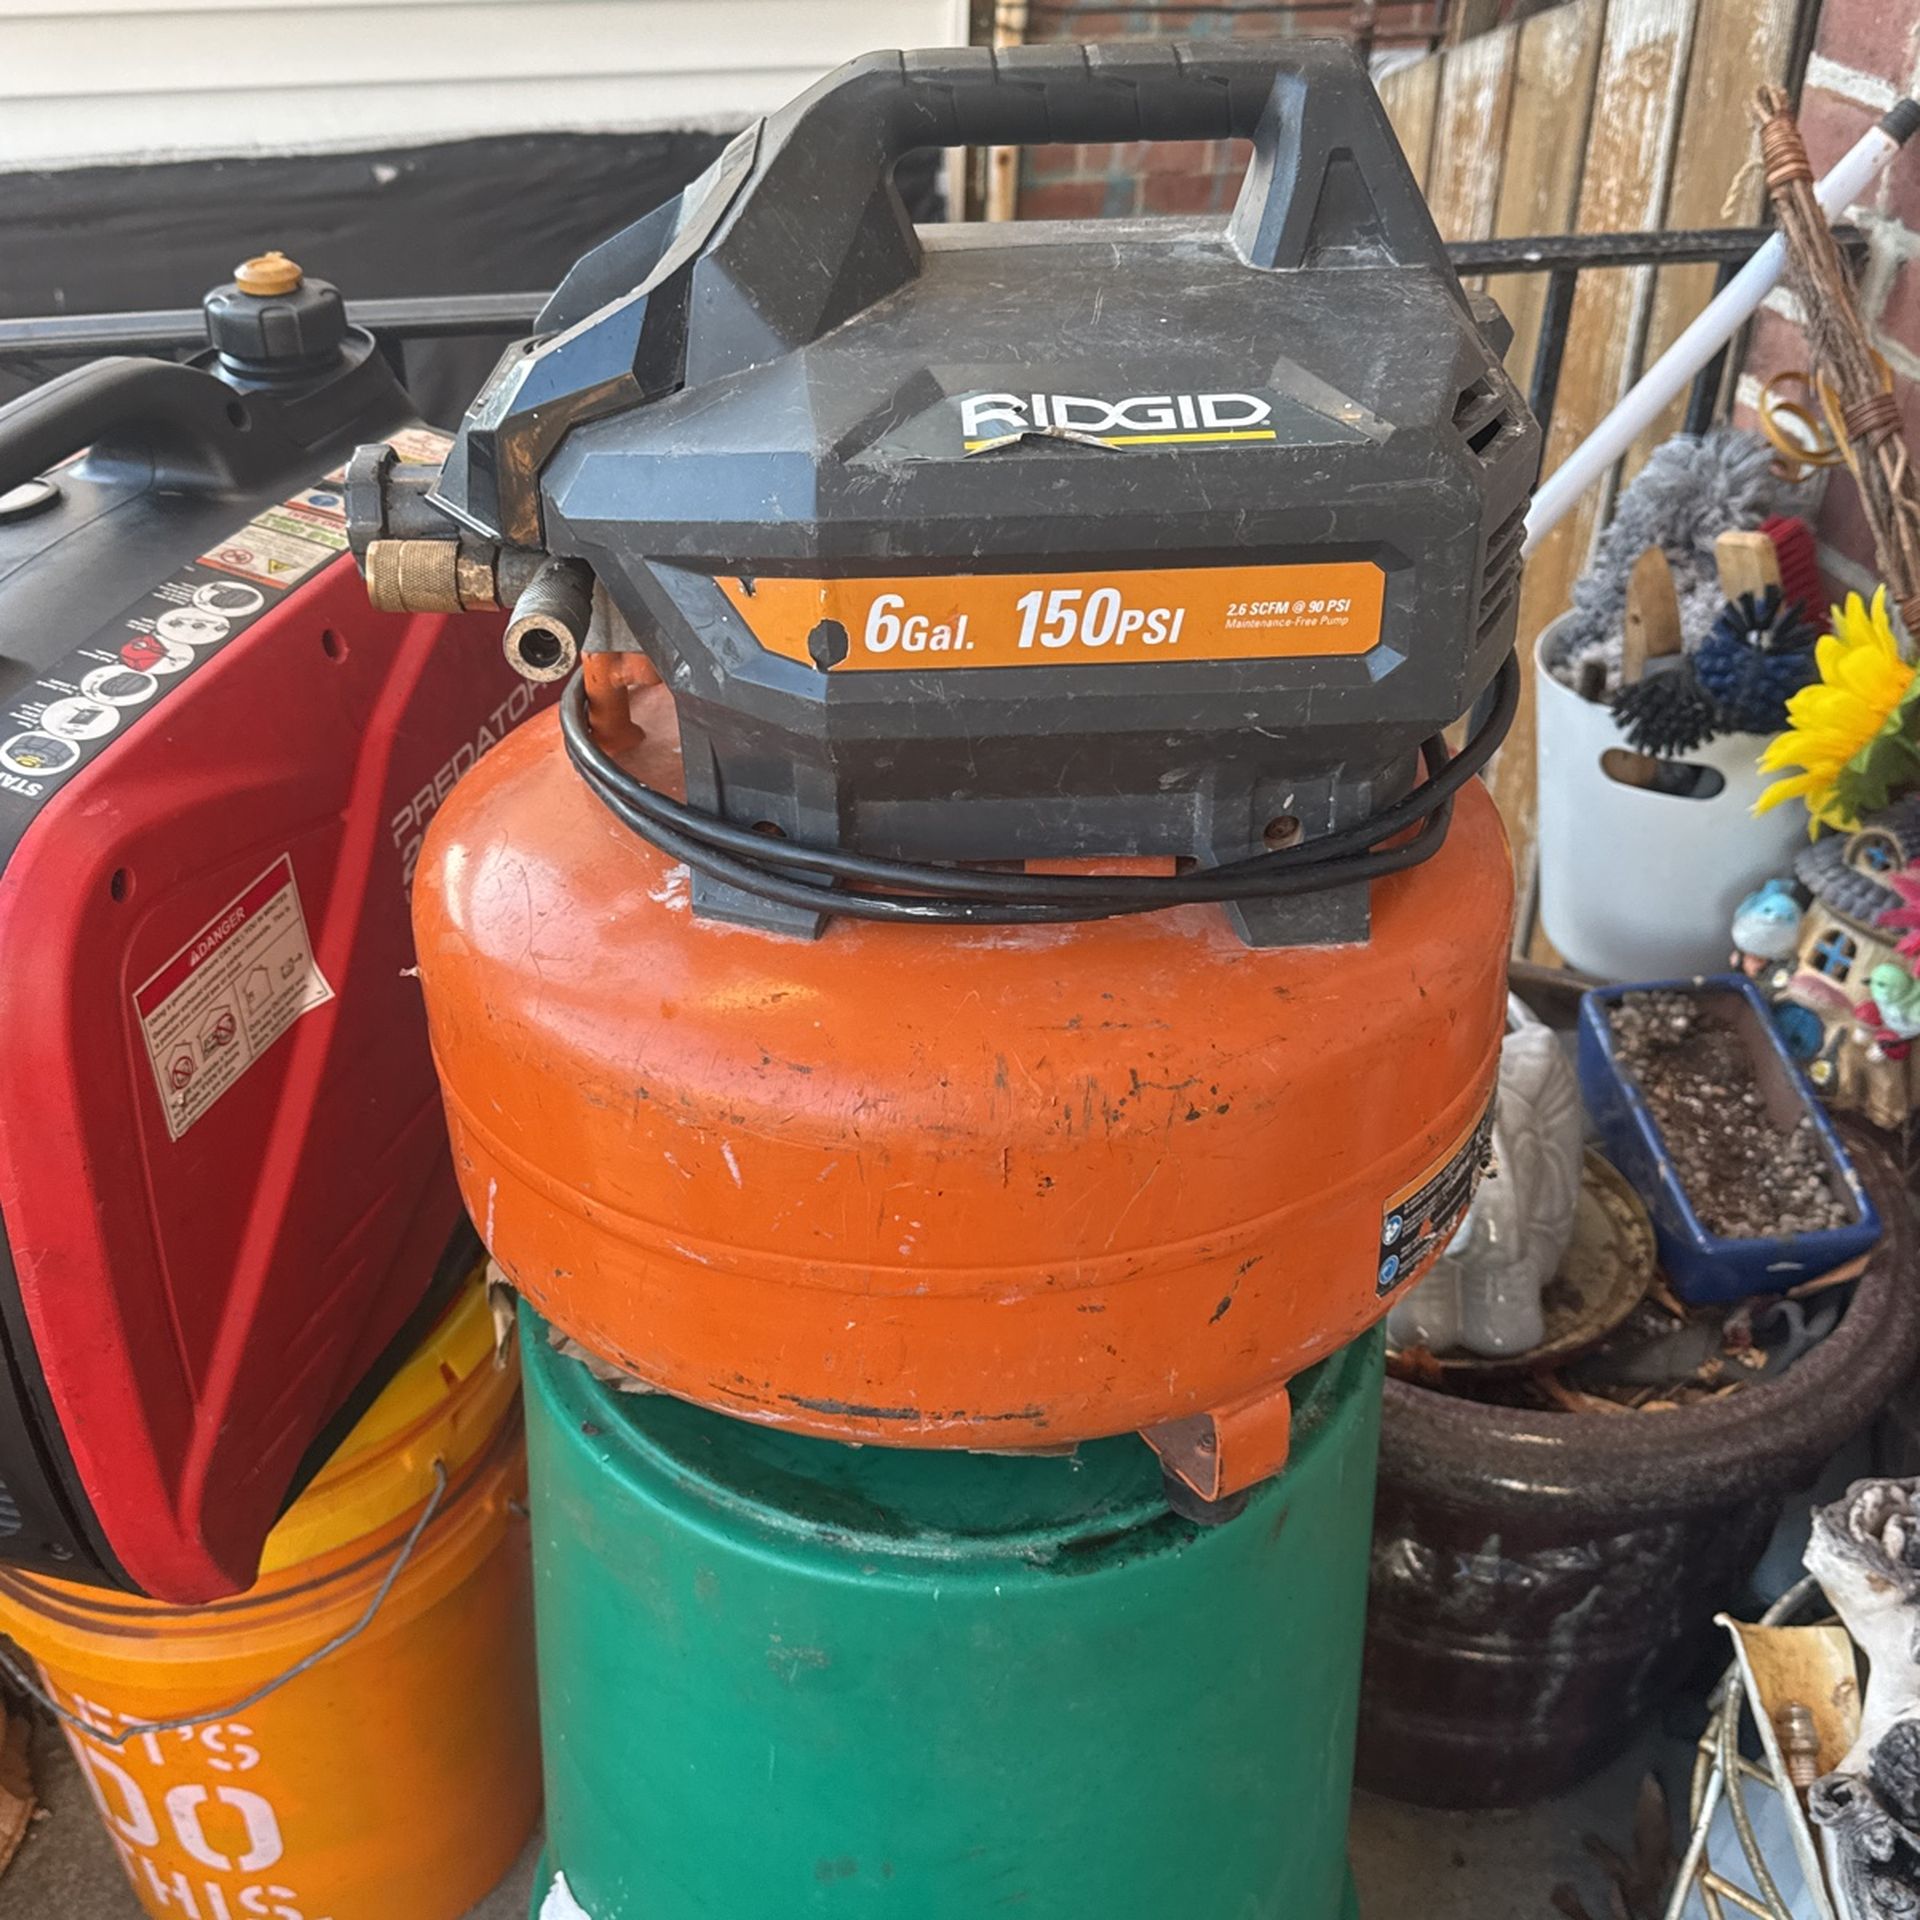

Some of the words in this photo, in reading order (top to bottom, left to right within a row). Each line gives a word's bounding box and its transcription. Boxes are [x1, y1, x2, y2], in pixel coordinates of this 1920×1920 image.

[961, 393, 1272, 436] RIDGID
[1225, 616, 1318, 629] Maintenance-Free
[1319, 614, 1349, 626] Pump
[1227, 603, 1248, 616] 2.6
[1249, 601, 1290, 615] SCFM
[1291, 600, 1306, 614] @
[1308, 600, 1325, 613] 90
[1326, 598, 1351, 612] PSI
[198, 906, 246, 958] DANGER
